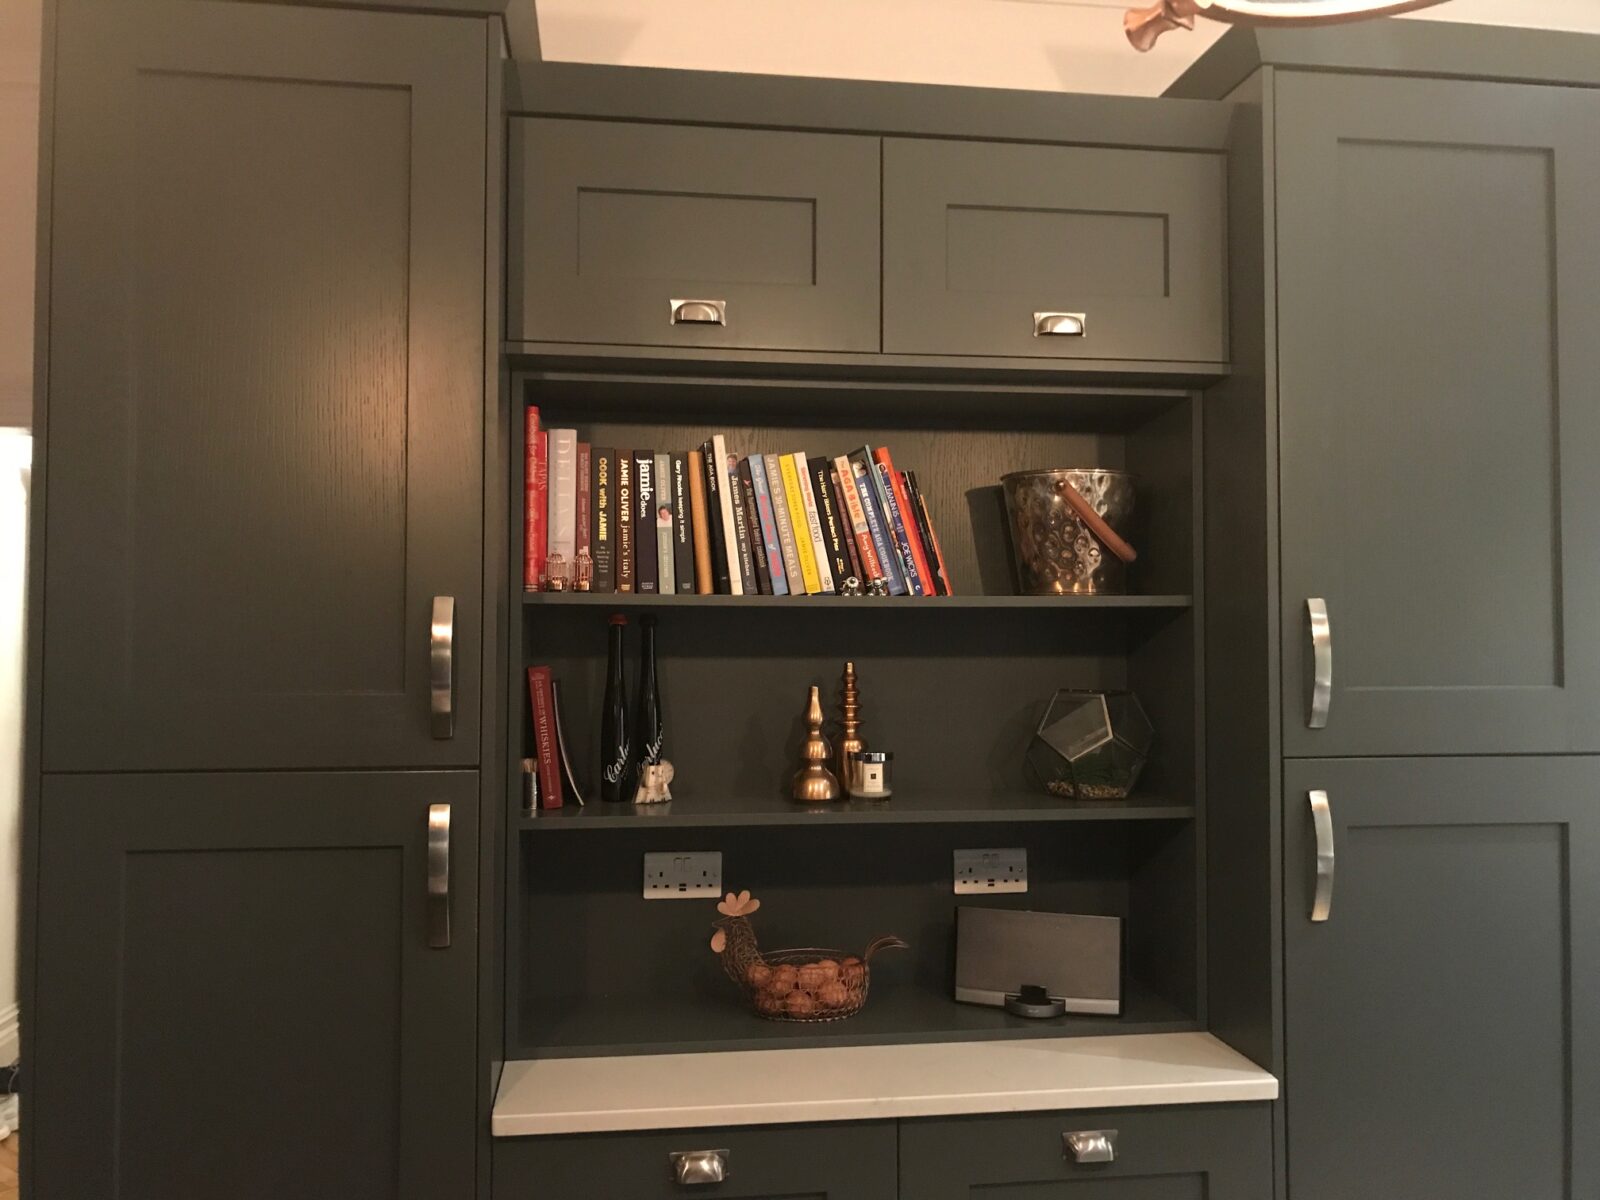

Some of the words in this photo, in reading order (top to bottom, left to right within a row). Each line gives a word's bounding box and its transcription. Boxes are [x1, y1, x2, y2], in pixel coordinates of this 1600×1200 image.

[538, 462, 547, 490] TAPAS
[598, 457, 608, 486] COOK
[620, 458, 629, 486] JAMIE
[636, 458, 653, 501] jamie
[674, 459, 682, 474] Gary
[598, 488, 608, 508] with
[730, 475, 741, 504] James
[841, 469, 852, 492] AGA
[849, 494, 860, 518] Bible
[859, 482, 868, 497] THE
[620, 488, 629, 522] OLIVER
[677, 497, 685, 519] keeping
[808, 510, 819, 525] fast
[863, 498, 878, 532] COMPLETE
[598, 510, 608, 541] JAMIE
[735, 507, 746, 539] Martin
[775, 495, 790, 544] 30-MINUTE
[786, 545, 798, 577] MEALS
[811, 525, 822, 543] food
[827, 516, 837, 538] Perfect
[832, 538, 840, 551] Pies
[620, 524, 631, 556] jamie's
[740, 542, 747, 552] my
[861, 533, 870, 551] Amy
[874, 533, 883, 546] AGA
[621, 558, 630, 579] italy
[743, 553, 751, 576] kitchen
[878, 547, 893, 581] COOKBOOK
[901, 541, 910, 555] JOE
[906, 555, 917, 578] WICKS
[538, 715, 551, 765] WHISKIES
